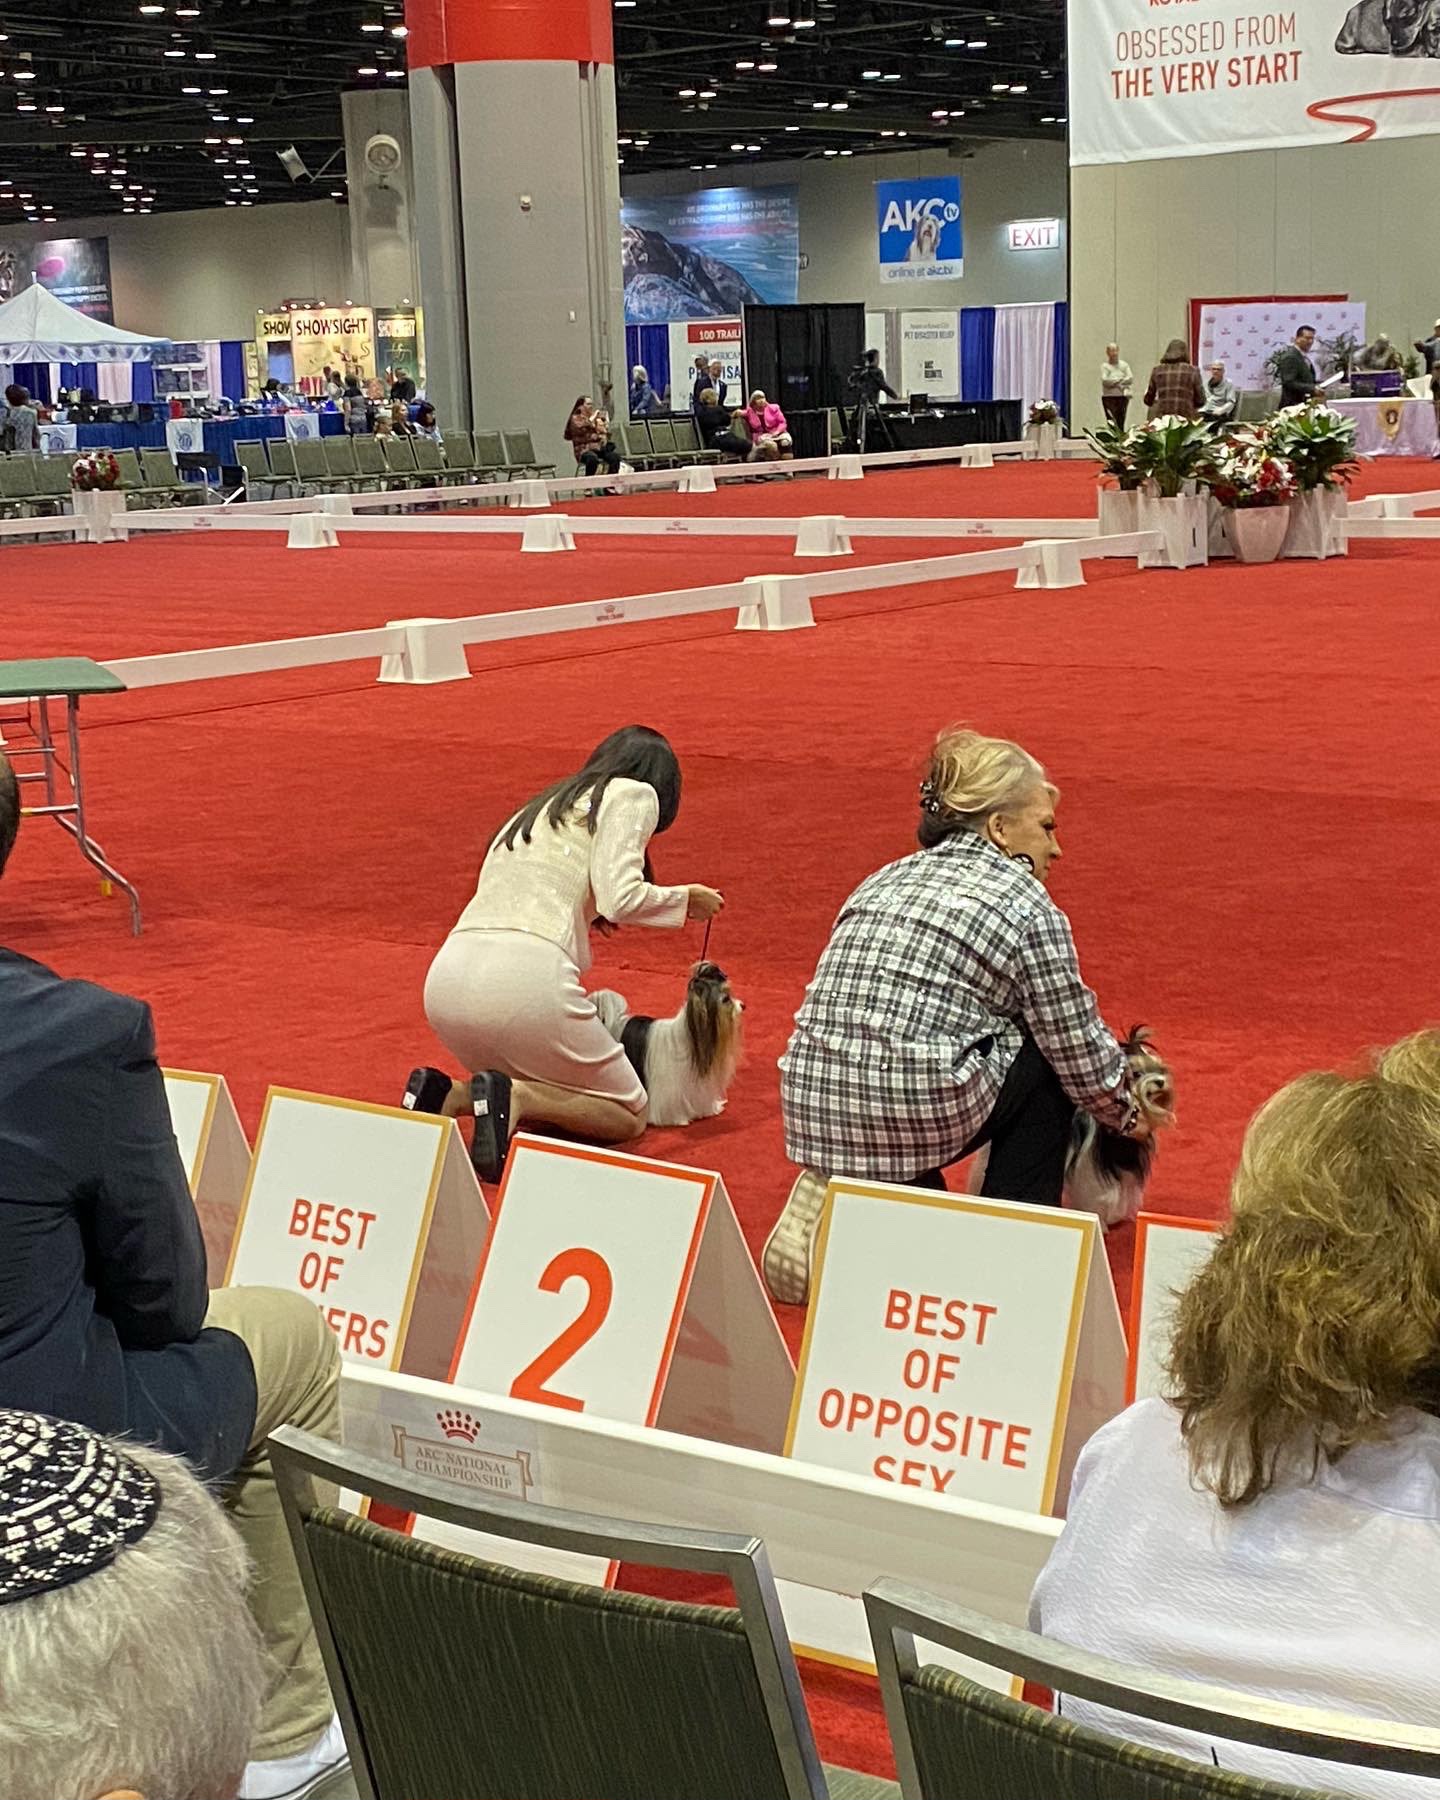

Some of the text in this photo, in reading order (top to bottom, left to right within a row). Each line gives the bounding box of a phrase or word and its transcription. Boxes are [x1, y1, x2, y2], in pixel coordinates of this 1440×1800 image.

[1116, 12, 1297, 61] OBSESSED FROM
[1111, 50, 1302, 99] THE VERY START
[881, 198, 946, 233] AKC
[1013, 227, 1054, 247] EXIT
[296, 318, 368, 336] SHOWSIGHT
[699, 330, 715, 340] 100
[288, 1198, 377, 1251] BEST
[299, 1251, 345, 1293] OF
[509, 1247, 613, 1413] 2
[884, 1288, 998, 1346] BEST
[903, 1348, 961, 1394] OF
[818, 1388, 1032, 1469] OPPOSITE
[415, 1459, 513, 1489] CHAMPIONSHIP
[445, 1451, 510, 1476] NATIONAL
